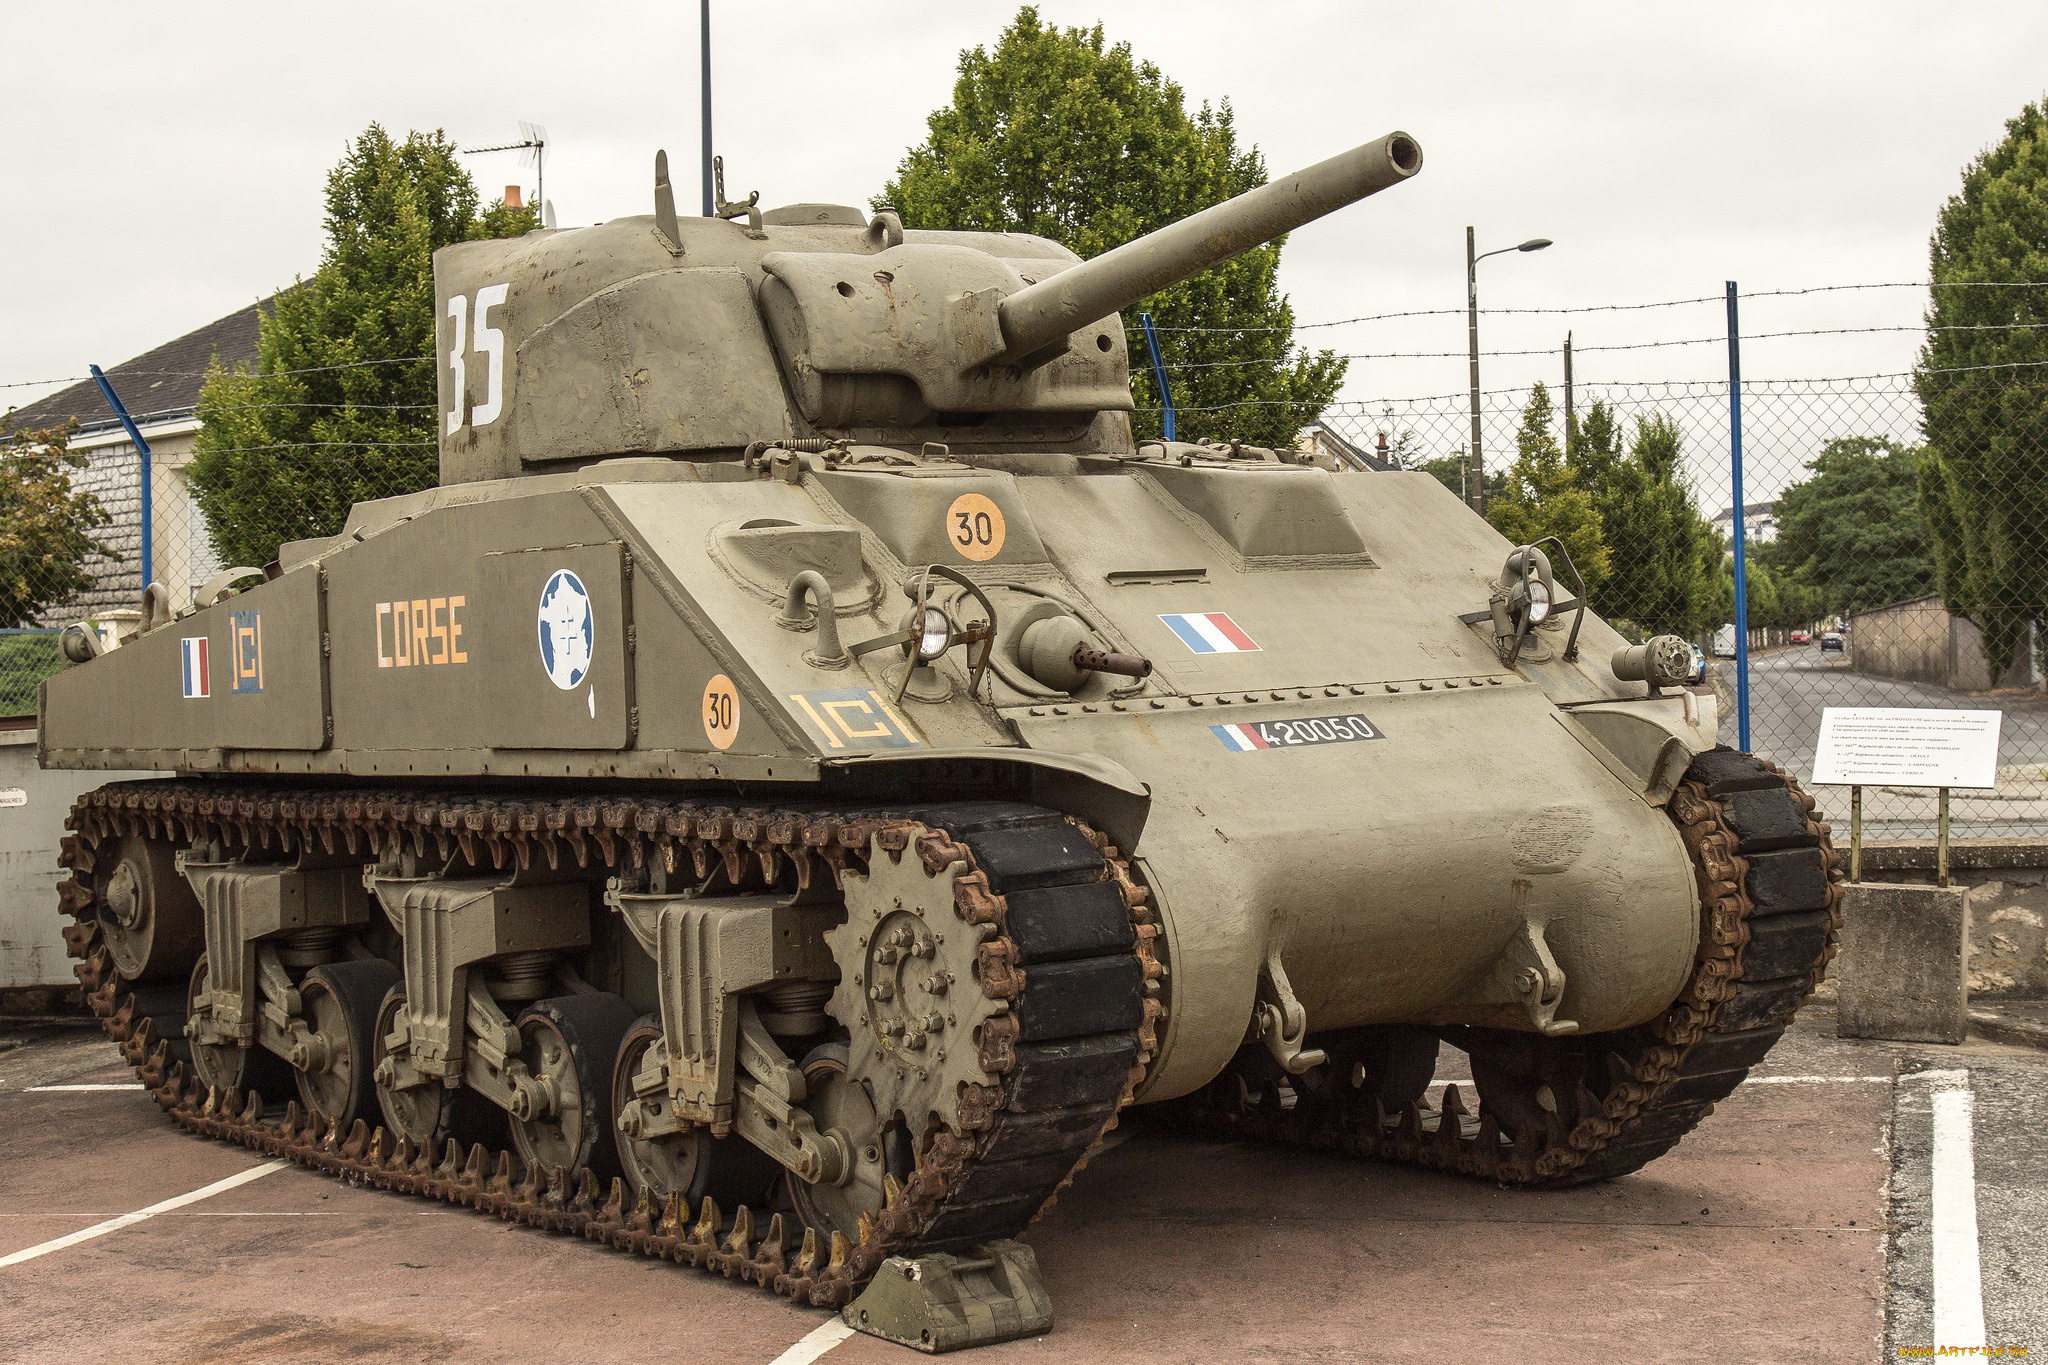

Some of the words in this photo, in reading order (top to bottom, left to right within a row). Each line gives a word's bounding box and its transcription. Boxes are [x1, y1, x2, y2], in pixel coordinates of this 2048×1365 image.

[447, 283, 510, 437] 35
[955, 511, 993, 546] 30
[375, 595, 468, 668] CORSE
[708, 692, 732, 730] 30
[1259, 716, 1376, 746] 420050
